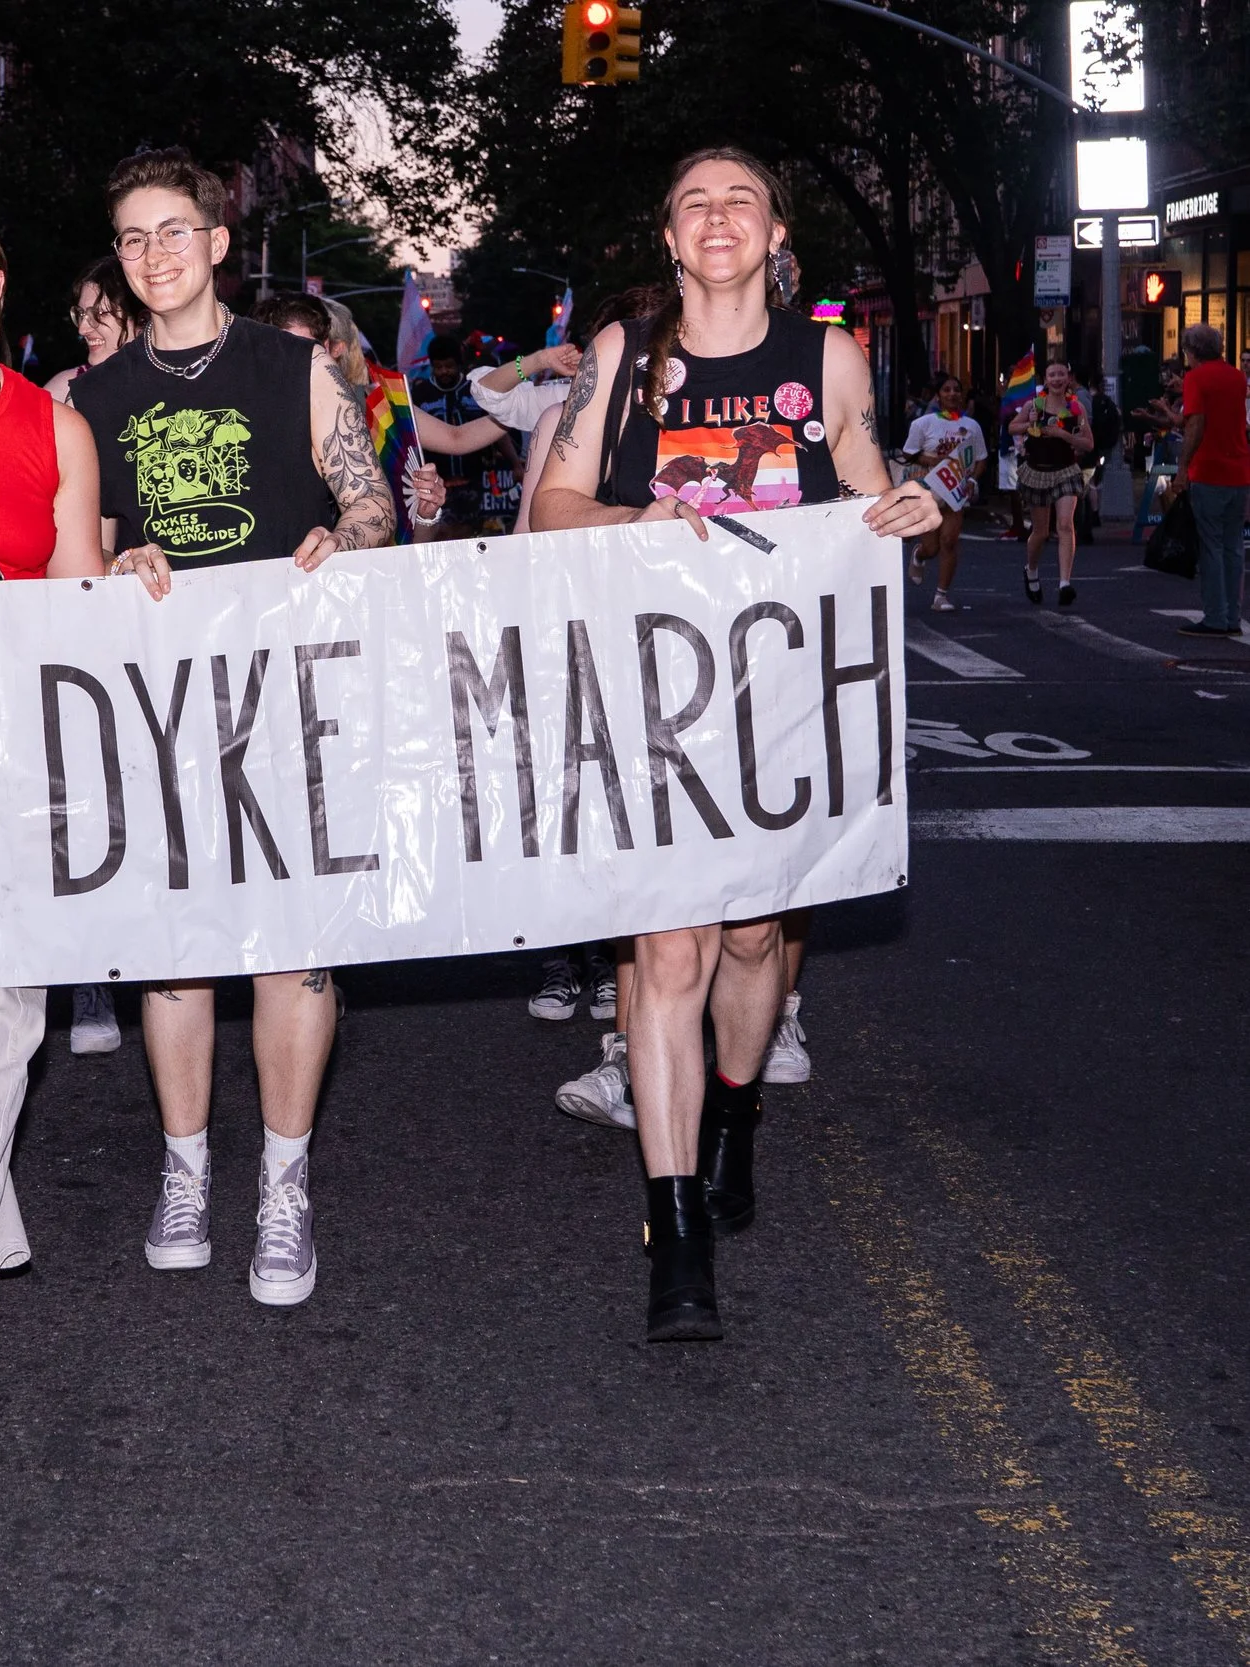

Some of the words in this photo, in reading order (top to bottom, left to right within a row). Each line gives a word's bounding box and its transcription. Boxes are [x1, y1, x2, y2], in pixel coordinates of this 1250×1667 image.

[1166, 191, 1219, 224] FRAMEBRIDGE
[781, 386, 810, 402] FUCK
[681, 398, 691, 424] I
[704, 395, 772, 426] LIKE
[782, 403, 806, 417] ICE!
[151, 513, 198, 532] DYKES
[157, 523, 208, 537] AGAINST
[171, 522, 249, 546] GENOCIDE!
[40, 640, 381, 897] DYKE
[445, 584, 894, 863] MARCH
